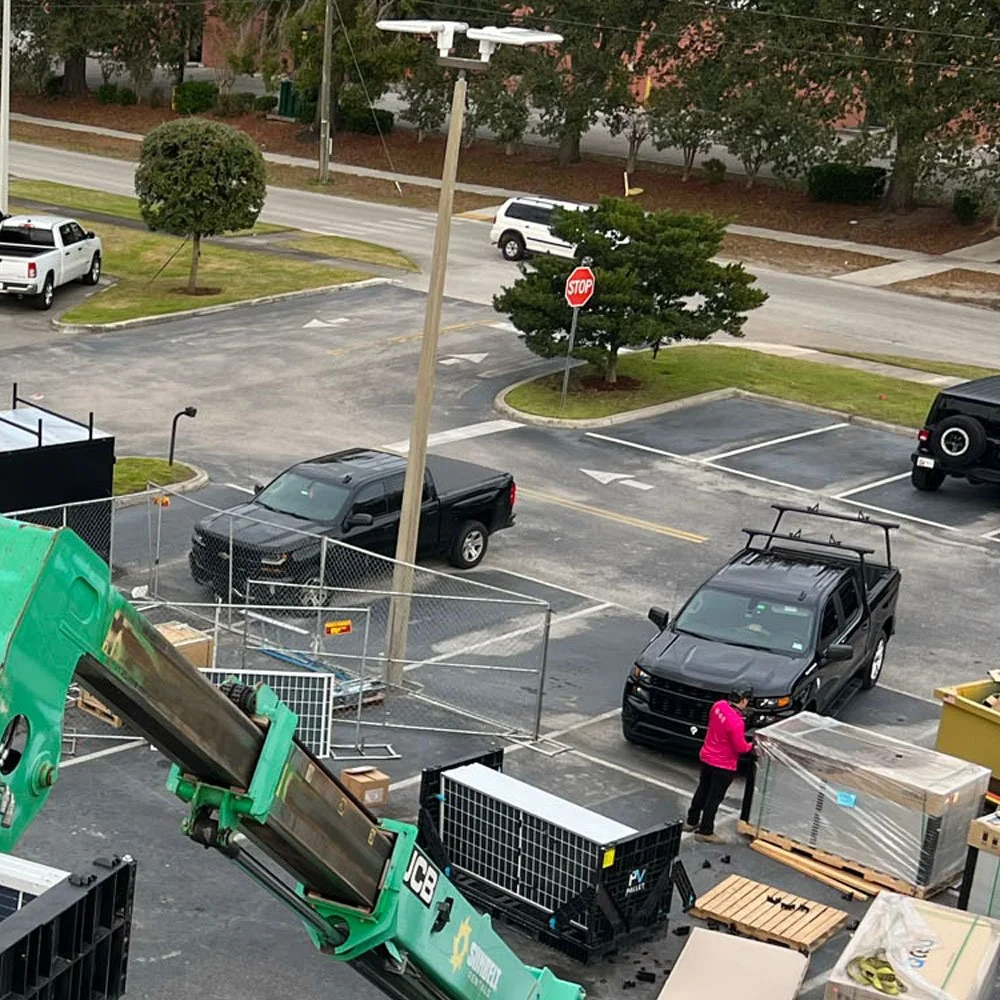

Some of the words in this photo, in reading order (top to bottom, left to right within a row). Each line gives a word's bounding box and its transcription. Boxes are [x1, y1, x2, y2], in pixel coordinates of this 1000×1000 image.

[568, 279, 592, 295] STOP
[404, 849, 438, 905] JCB
[628, 868, 646, 886] PV
